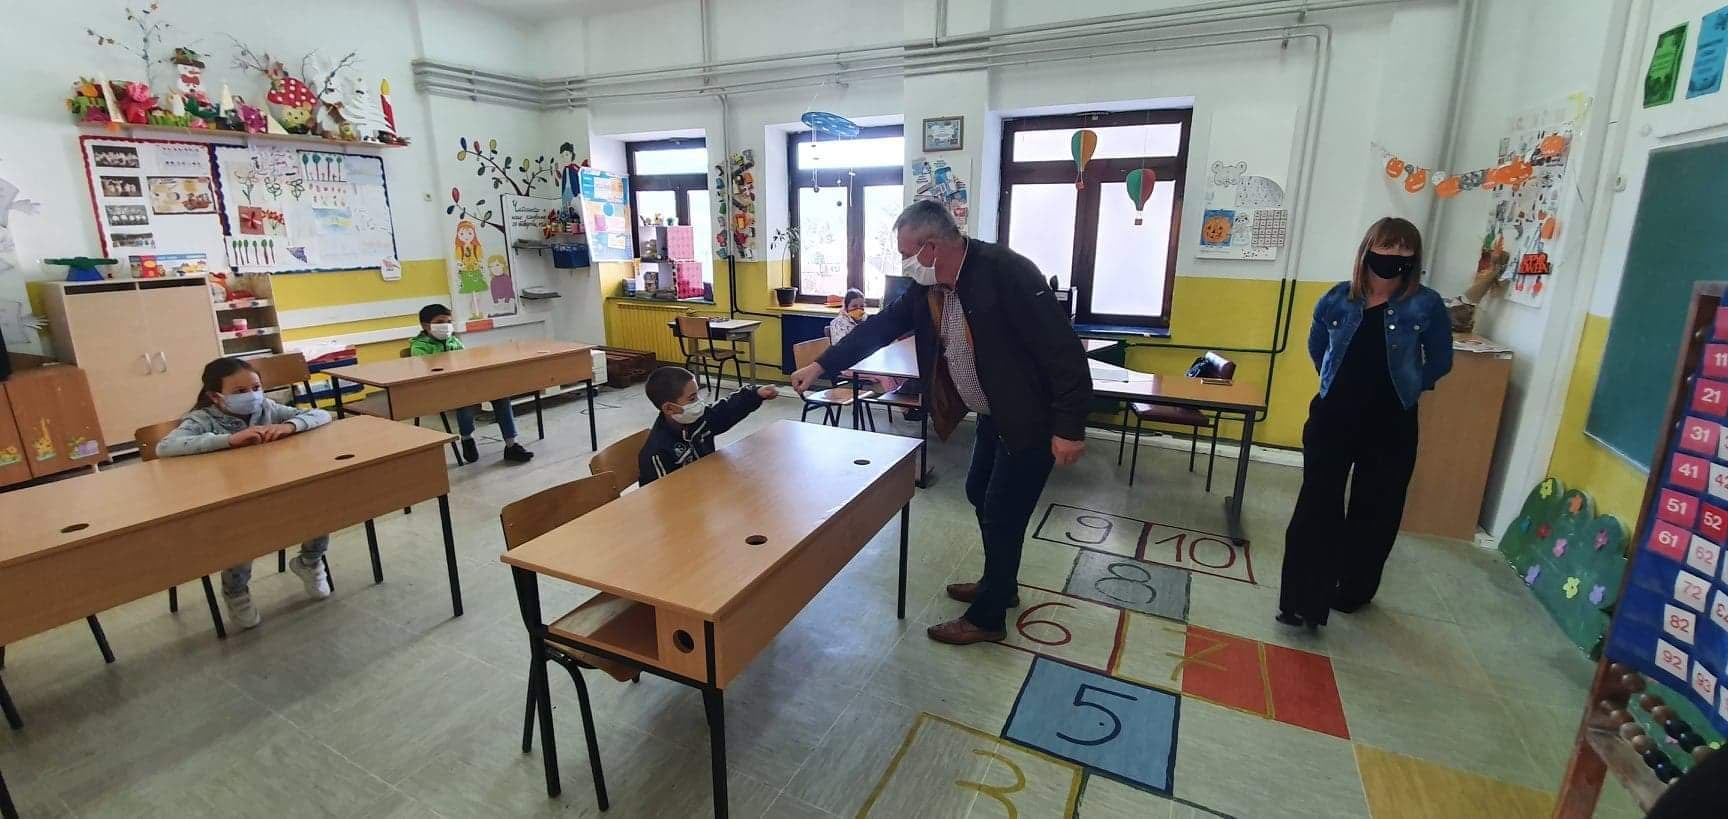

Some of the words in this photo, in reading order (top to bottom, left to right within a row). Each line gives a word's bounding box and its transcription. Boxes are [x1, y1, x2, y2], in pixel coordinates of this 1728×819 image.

[1702, 388, 1722, 404] 21
[1690, 426, 1711, 443] 31
[1679, 463, 1699, 479] 41
[1666, 498, 1688, 515] 51
[1065, 515, 1114, 545] 9
[1703, 511, 1722, 531] 52
[1658, 530, 1679, 548] 61
[1155, 533, 1237, 569] 10
[1695, 546, 1713, 565] 62
[1094, 562, 1157, 604] 8
[1683, 580, 1702, 600] 72
[1016, 602, 1079, 646] 6
[1670, 614, 1689, 633] 82
[1163, 627, 1231, 681] 7
[1662, 650, 1682, 670] 92
[1056, 683, 1138, 746] 5
[956, 749, 1026, 819] 3
